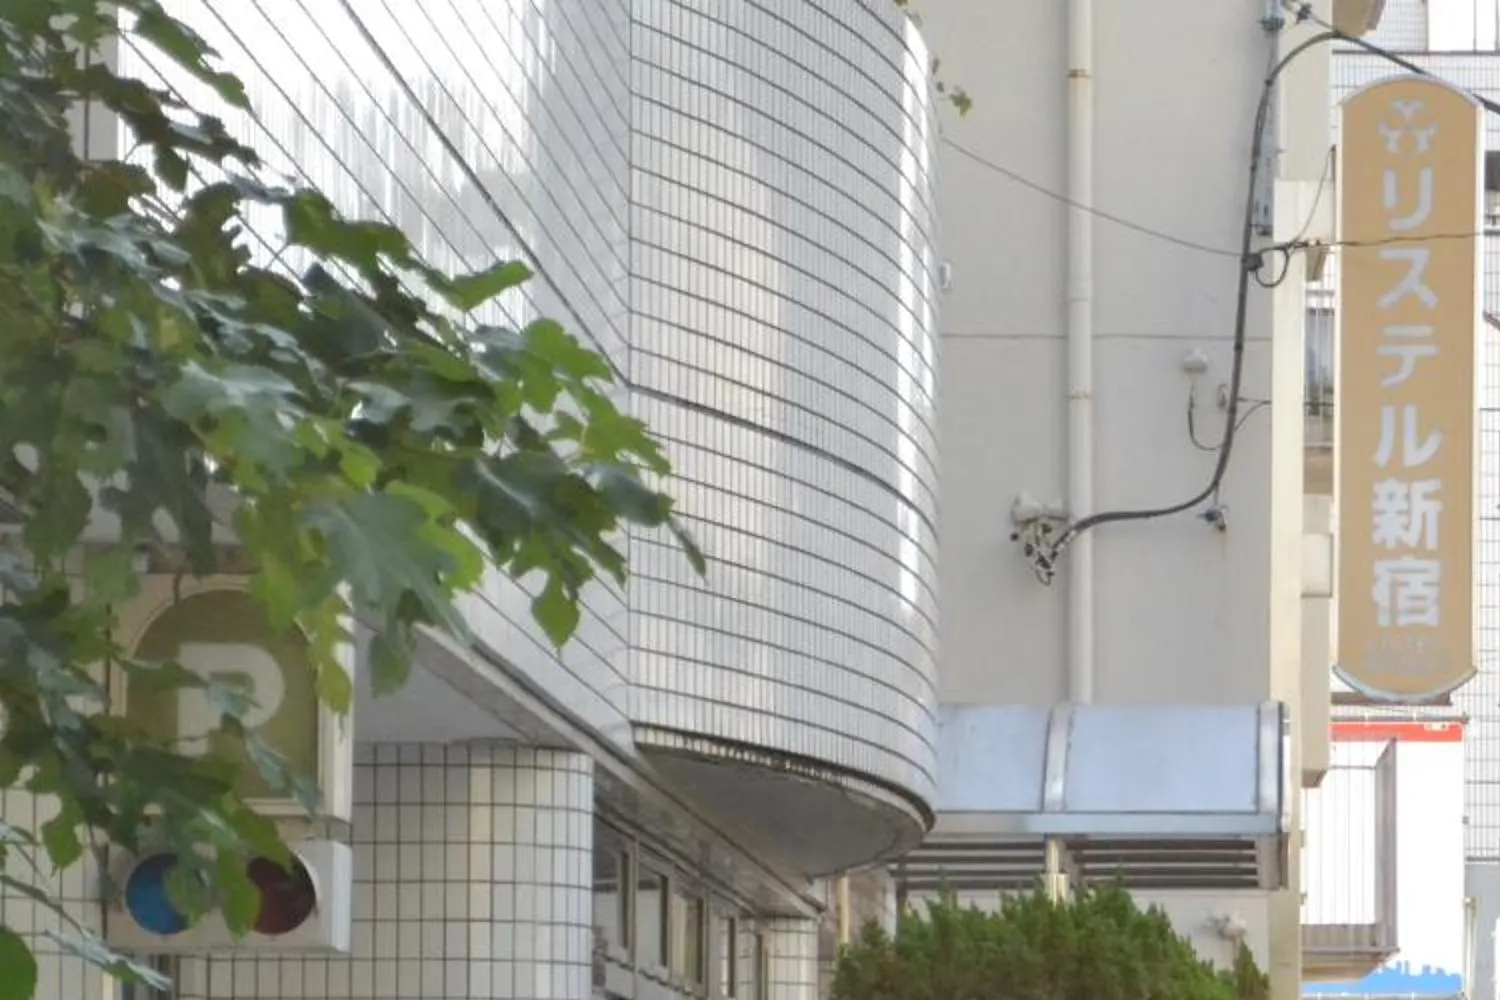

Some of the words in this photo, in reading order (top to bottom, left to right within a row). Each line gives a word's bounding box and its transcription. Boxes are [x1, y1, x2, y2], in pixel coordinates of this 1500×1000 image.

[1372, 167, 1442, 628] リステル新宿
